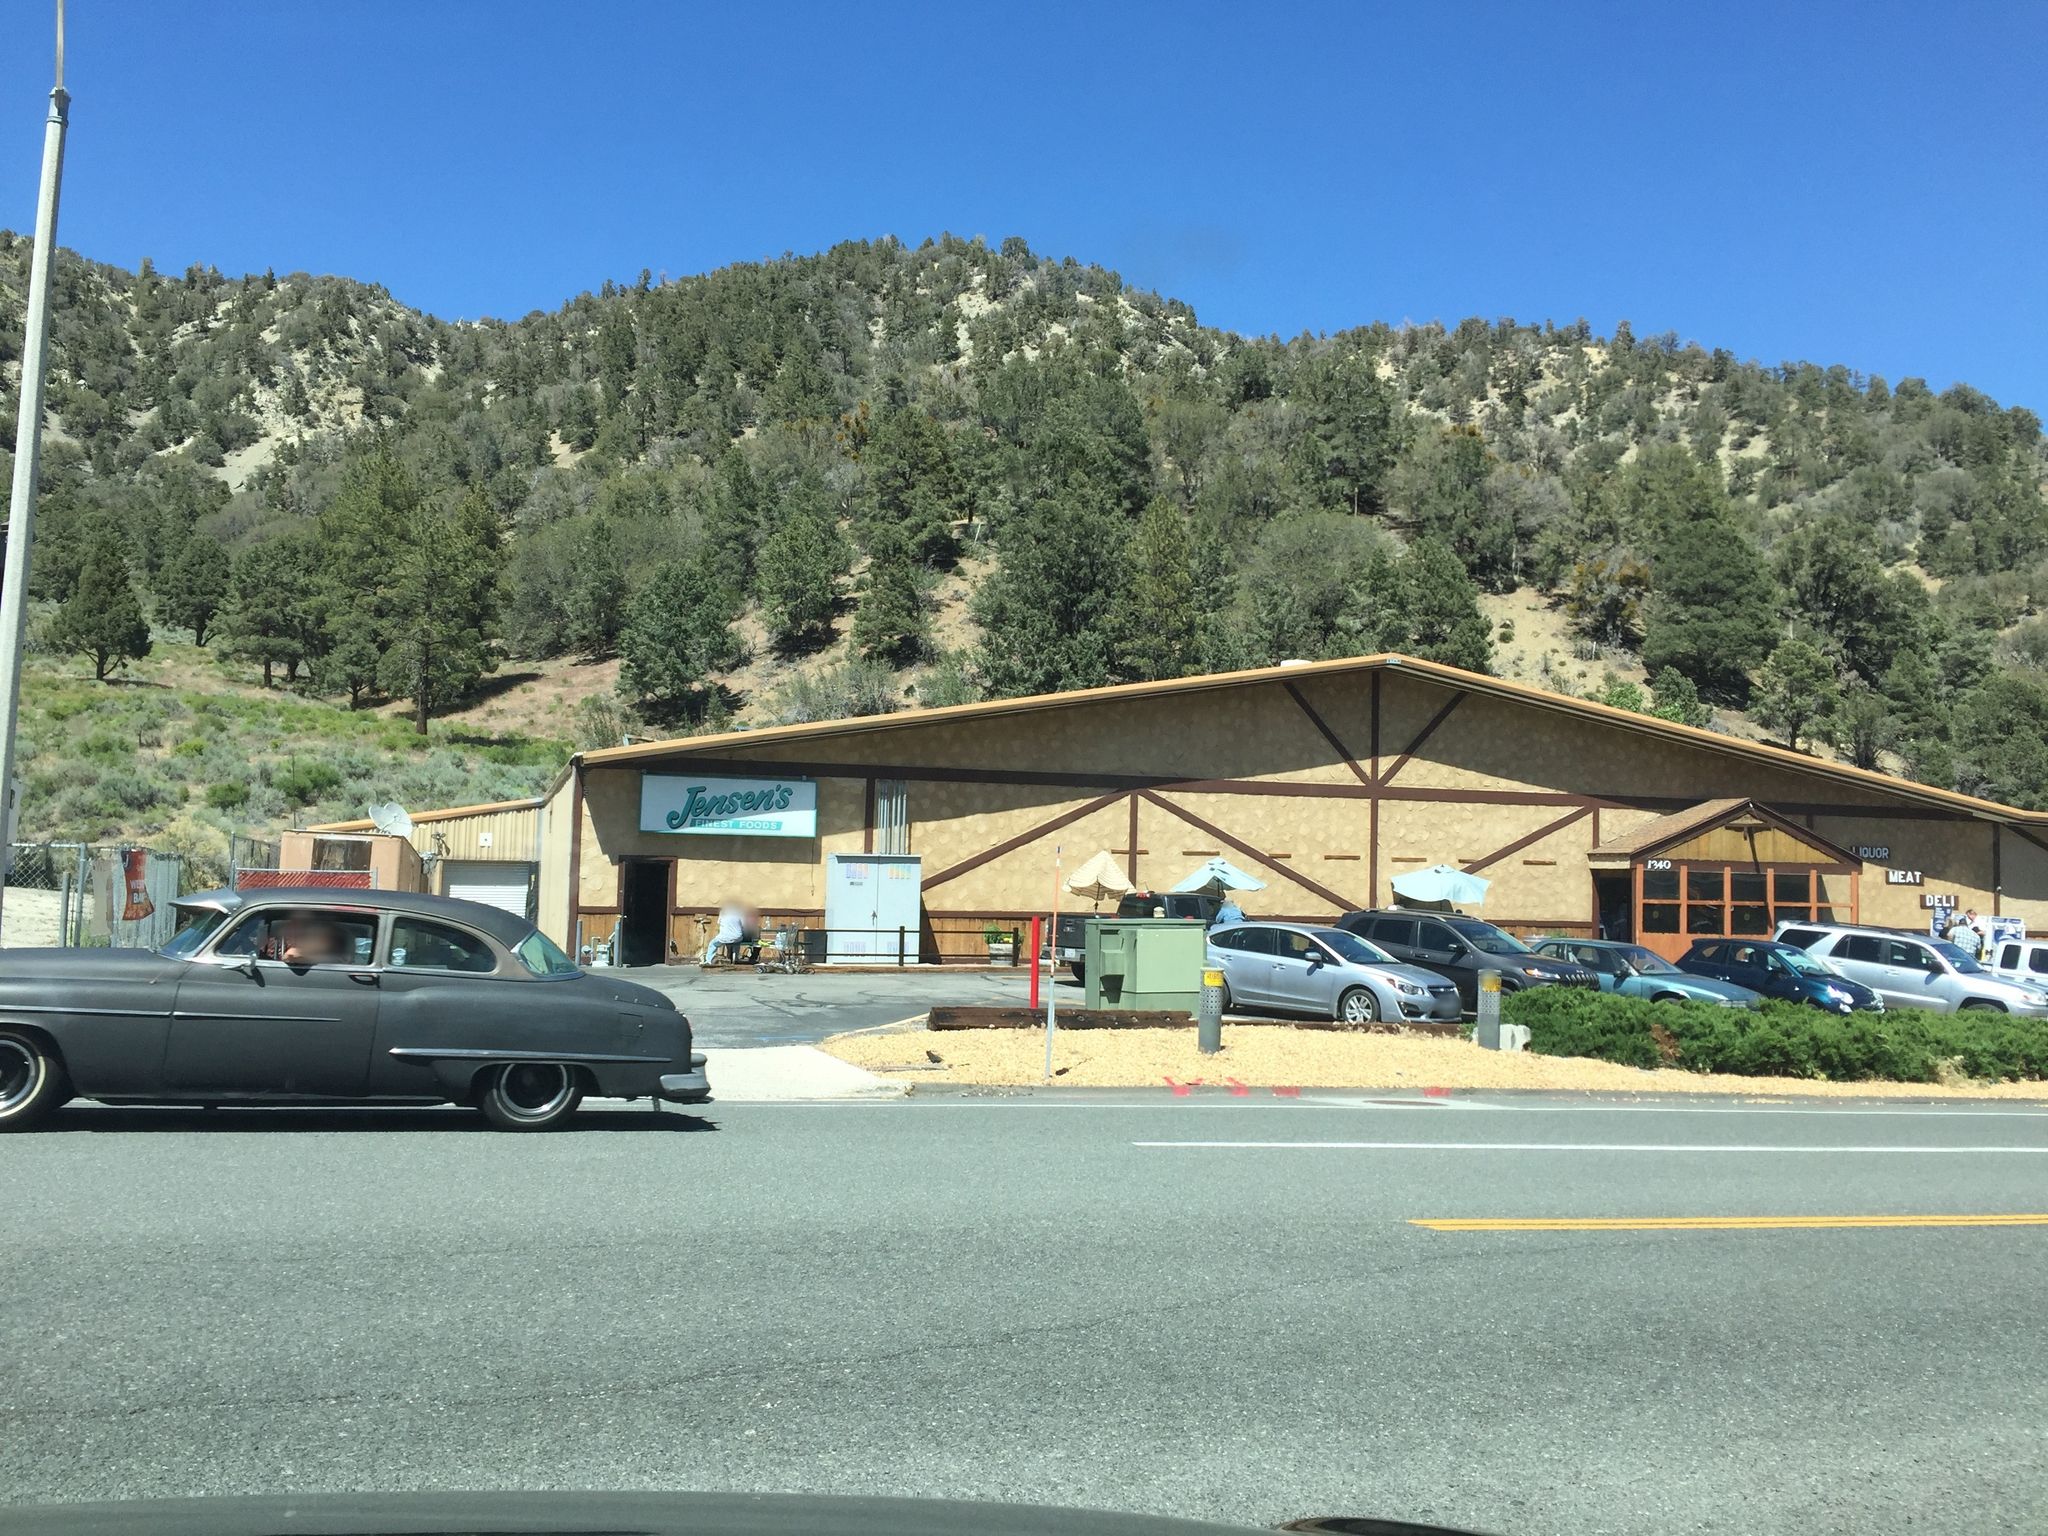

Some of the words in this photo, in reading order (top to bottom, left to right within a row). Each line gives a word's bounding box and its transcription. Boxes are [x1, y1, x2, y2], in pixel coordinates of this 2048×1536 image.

[666, 784, 793, 829] Jensen's
[695, 819, 734, 829] FINEST
[739, 820, 777, 830] FOODS
[1647, 859, 1672, 870] 1340
[1888, 870, 1922, 884] MEAT
[1925, 894, 1955, 907] DELI
